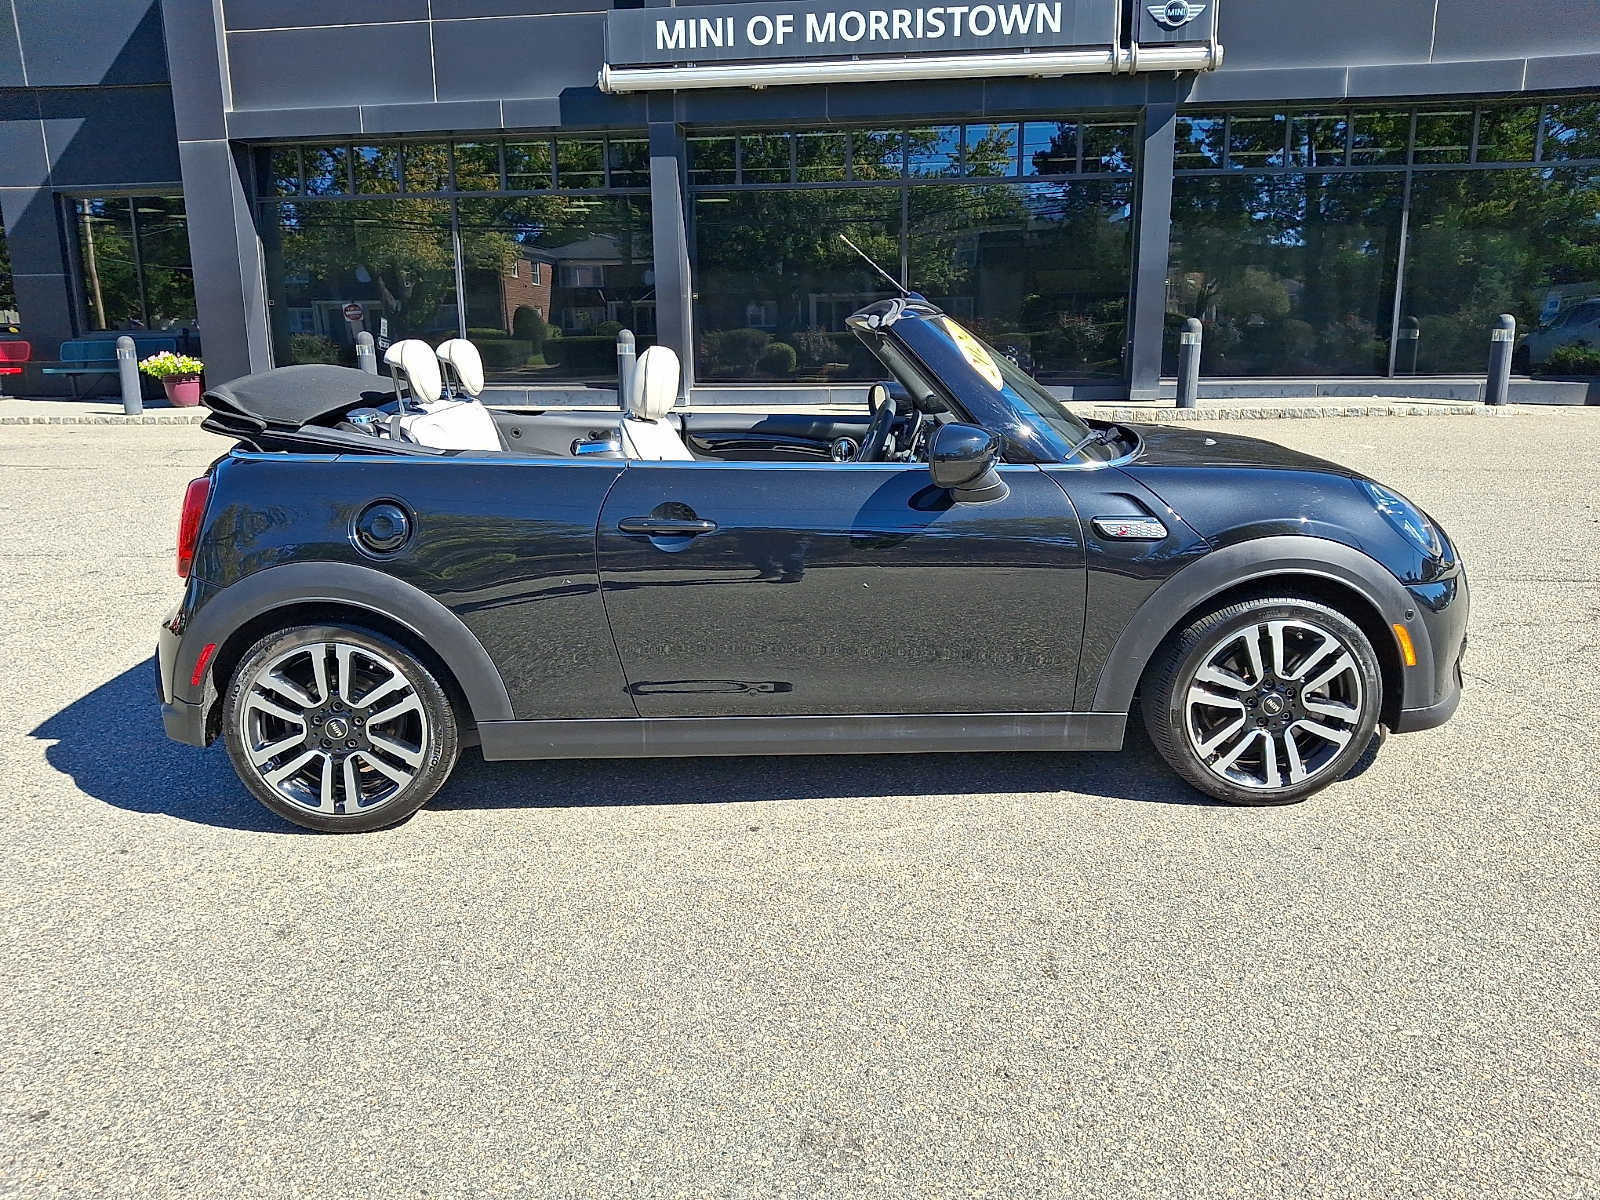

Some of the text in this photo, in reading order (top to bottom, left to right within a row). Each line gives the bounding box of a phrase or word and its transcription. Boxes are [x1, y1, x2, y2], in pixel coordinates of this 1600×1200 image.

[655, 2, 1062, 50] MINI OF MORRISTOWN
[1167, 8, 1187, 16] MINI
